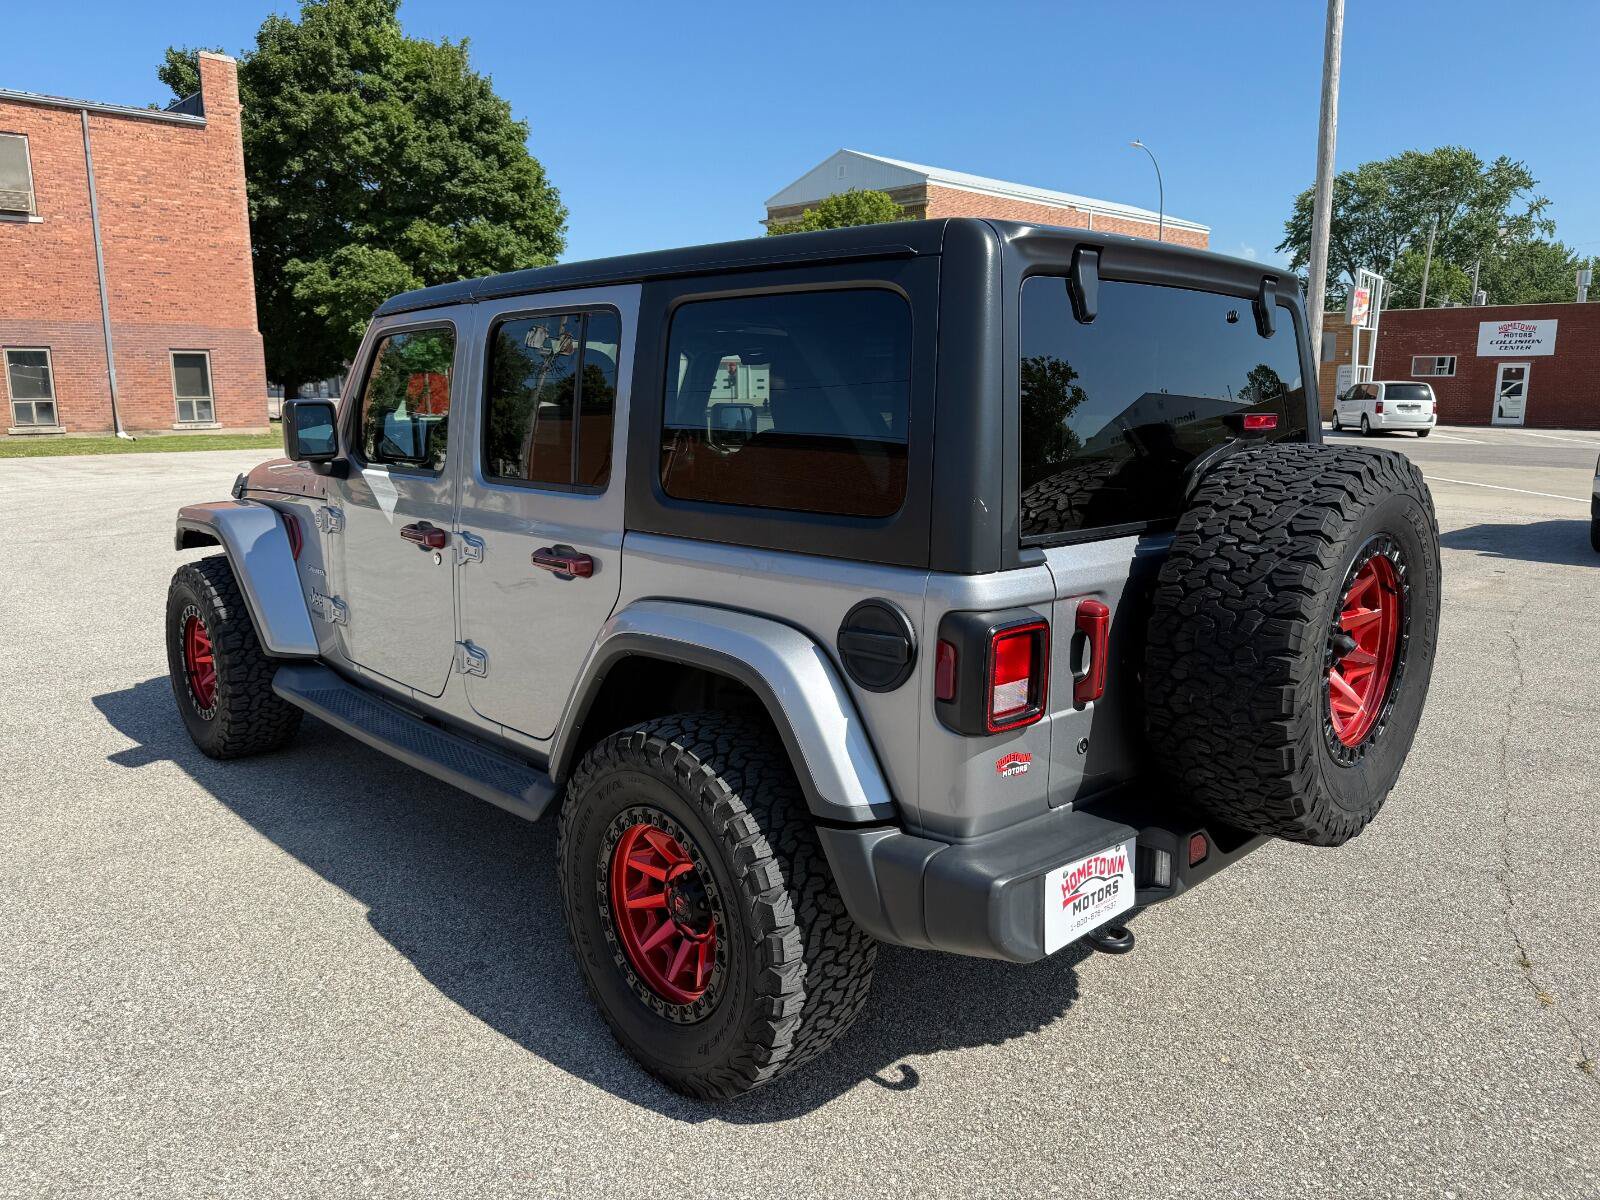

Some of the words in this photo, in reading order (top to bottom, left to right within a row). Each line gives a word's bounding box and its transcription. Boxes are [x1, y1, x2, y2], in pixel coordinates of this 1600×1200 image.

[1498, 322, 1538, 331] HOMETOWN
[996, 752, 1032, 769] HOMETOWN
[1002, 764, 1028, 778] MOTORS
[1061, 855, 1126, 898] HOMETOWN
[1072, 880, 1119, 916] MOTORS
